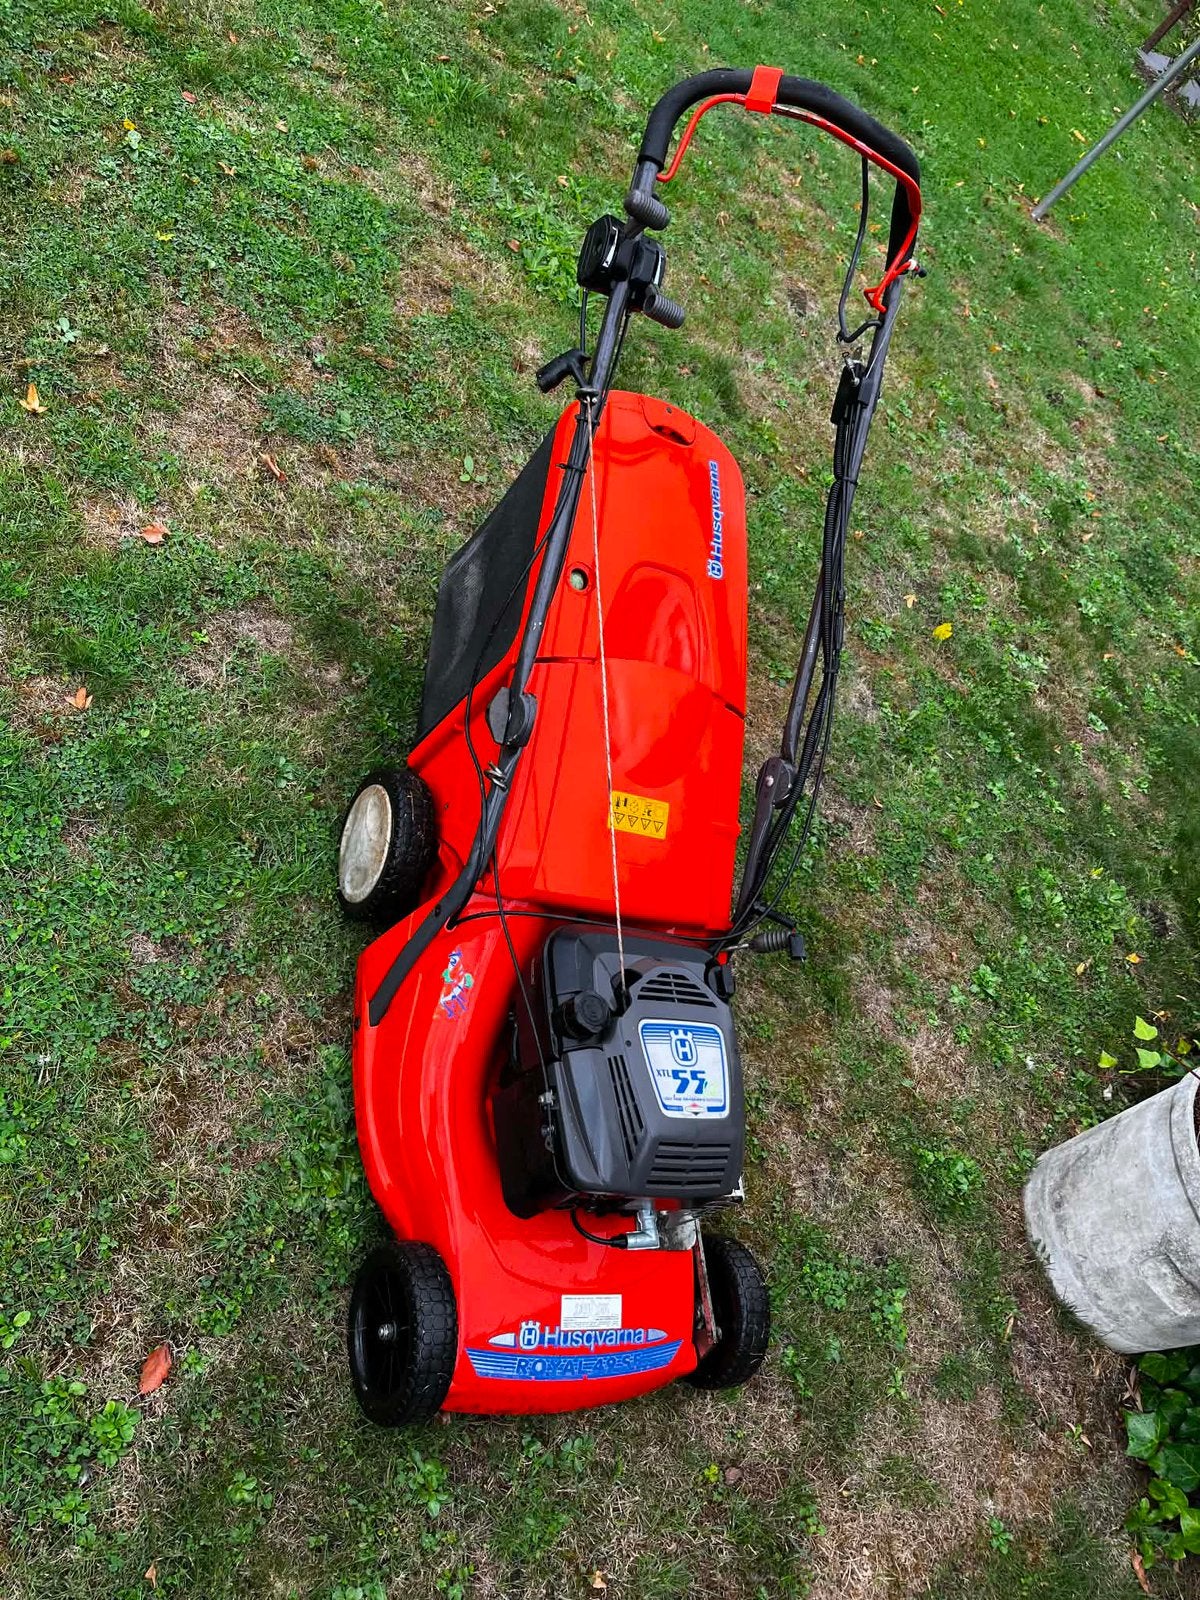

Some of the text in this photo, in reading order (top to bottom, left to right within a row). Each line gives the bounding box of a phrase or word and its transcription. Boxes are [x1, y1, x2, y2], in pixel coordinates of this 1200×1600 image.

[709, 461, 723, 557] Husqvarna
[656, 1069, 671, 1077] XTL
[544, 1326, 645, 1351] Husqvarna
[515, 1357, 588, 1376] ROYAL
